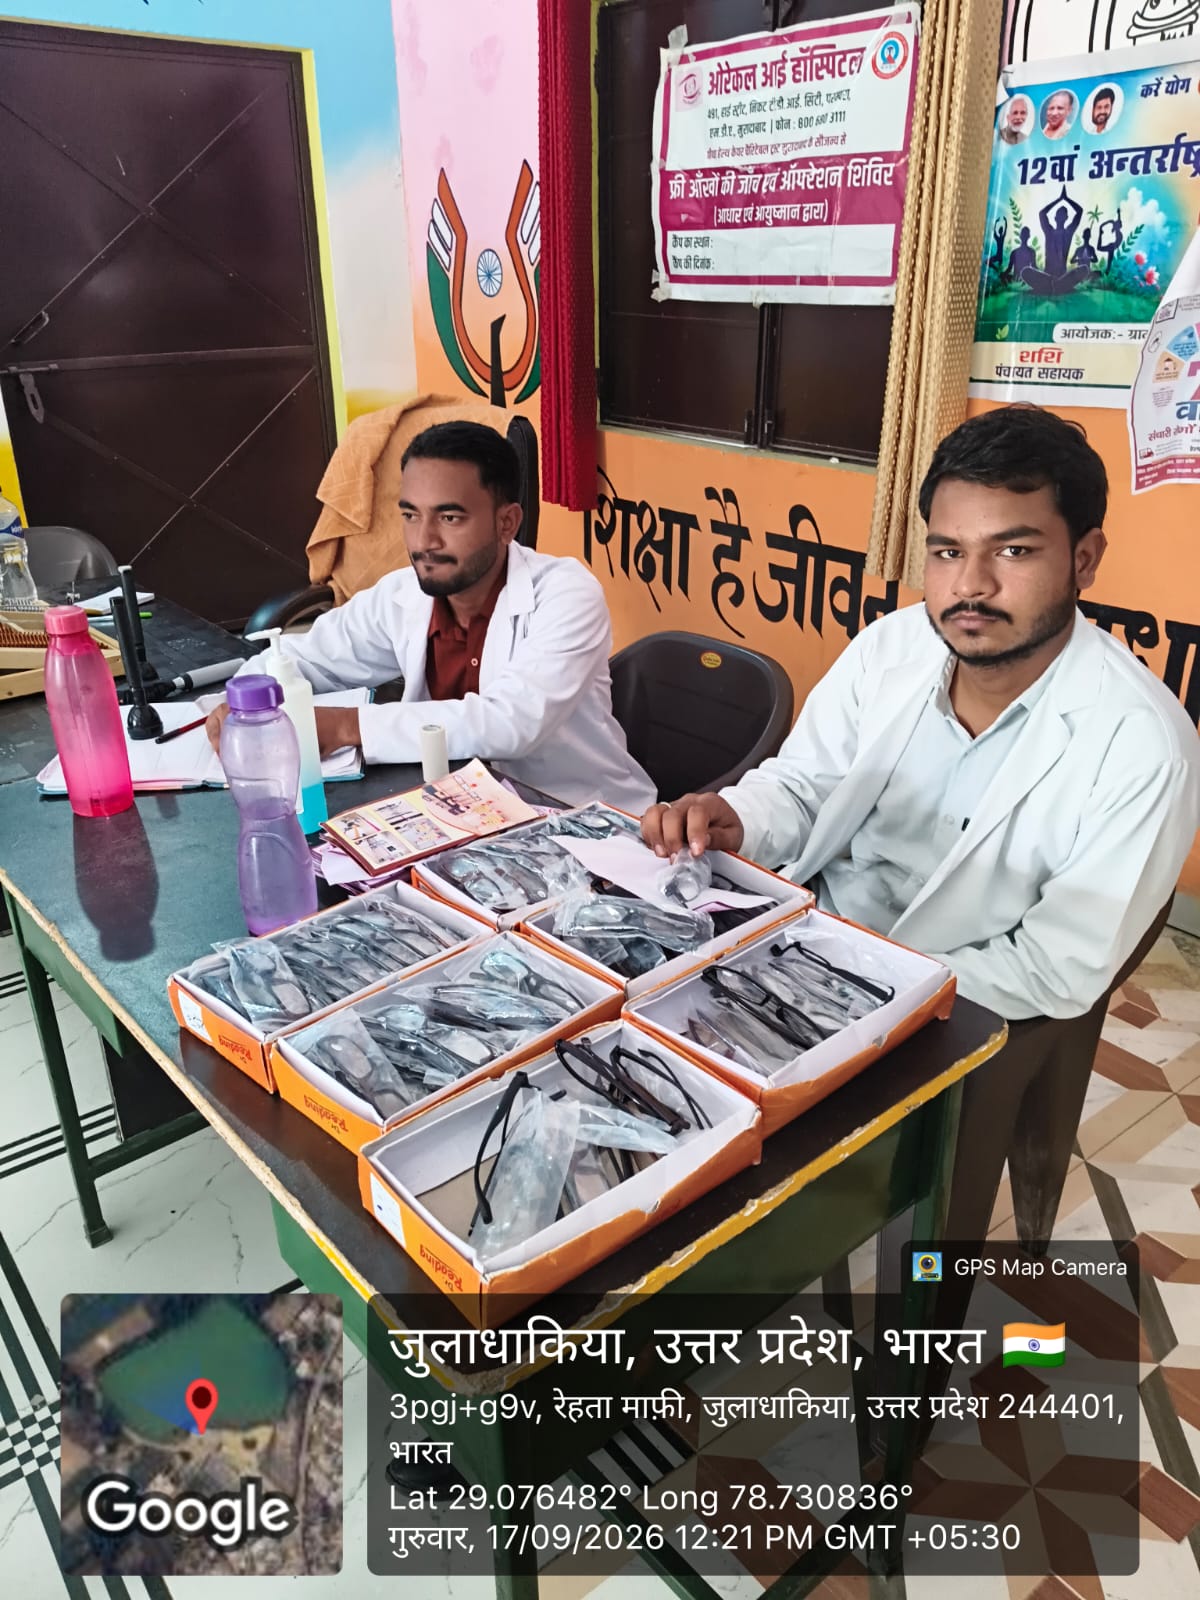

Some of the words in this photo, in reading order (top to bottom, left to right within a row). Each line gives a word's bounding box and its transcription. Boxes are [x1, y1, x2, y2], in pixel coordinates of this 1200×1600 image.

[708, 61, 757, 95] ओरेकल
[761, 50, 788, 89] आई
[790, 44, 866, 84] हॉस्पिटल
[1140, 77, 1163, 98] करें
[1165, 74, 1192, 95] योग
[669, 171, 685, 200] फ्री
[689, 170, 719, 198] आँखों
[720, 170, 736, 196] की
[761, 169, 780, 194] एवं
[781, 161, 844, 192] ऑपरेशन
[847, 157, 895, 188] शिविर
[1017, 144, 1081, 185] 12वां
[755, 203, 800, 227] आयुष्मान
[801, 199, 828, 223] द्वारा)
[995, 363, 1033, 379] पंचायत
[1037, 367, 1085, 380] सहायक
[1019, 347, 1064, 363] शशि
[704, 486, 753, 639] है
[303, 1094, 349, 1132] Reading
[420, 1244, 463, 1292] Reading
